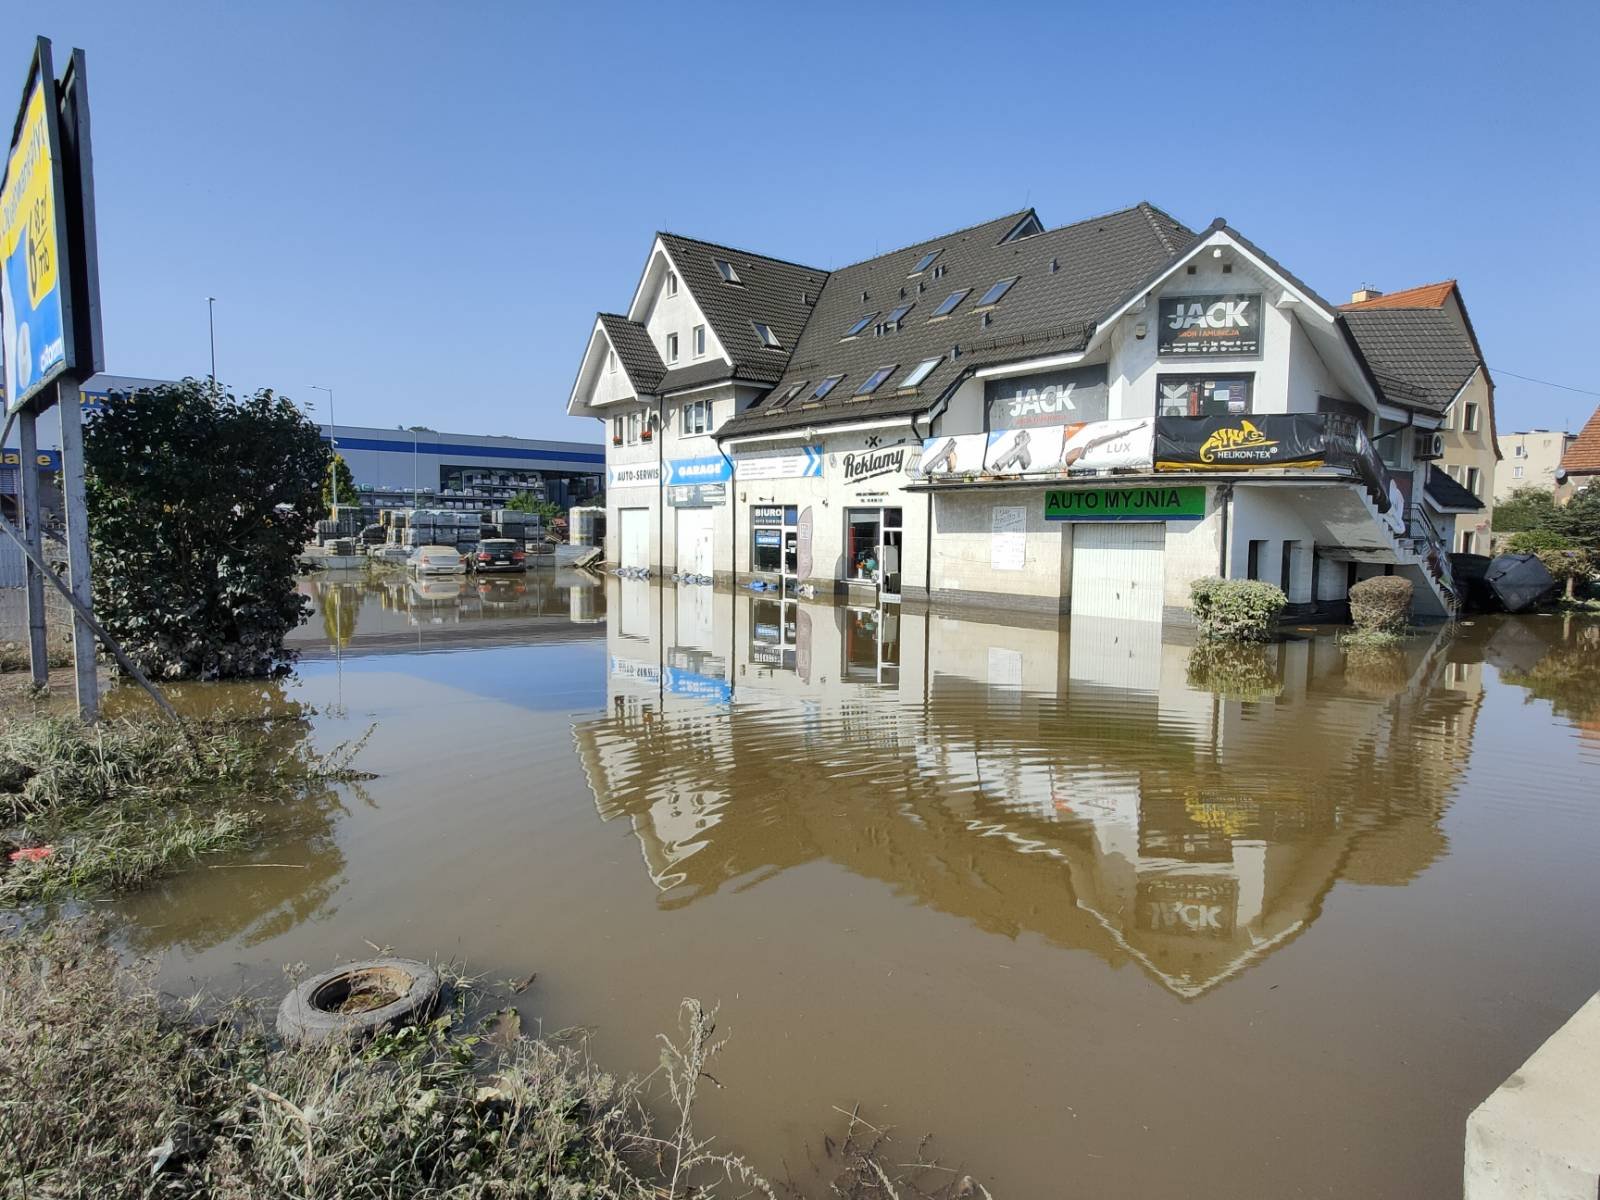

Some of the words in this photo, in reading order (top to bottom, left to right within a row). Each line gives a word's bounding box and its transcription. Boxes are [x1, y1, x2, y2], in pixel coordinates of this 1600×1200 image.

[1167, 301, 1250, 330] JACK
[1008, 382, 1077, 417] JACK
[1106, 442, 1132, 454] LUX
[1217, 450, 1271, 460] HELIKON-TEX
[843, 449, 905, 479] Reklamy
[617, 468, 660, 482] AUTO-SERWIS
[1048, 492, 1099, 509] AUTO
[1104, 489, 1181, 509] MYJNIA
[755, 508, 782, 517] BIURO
